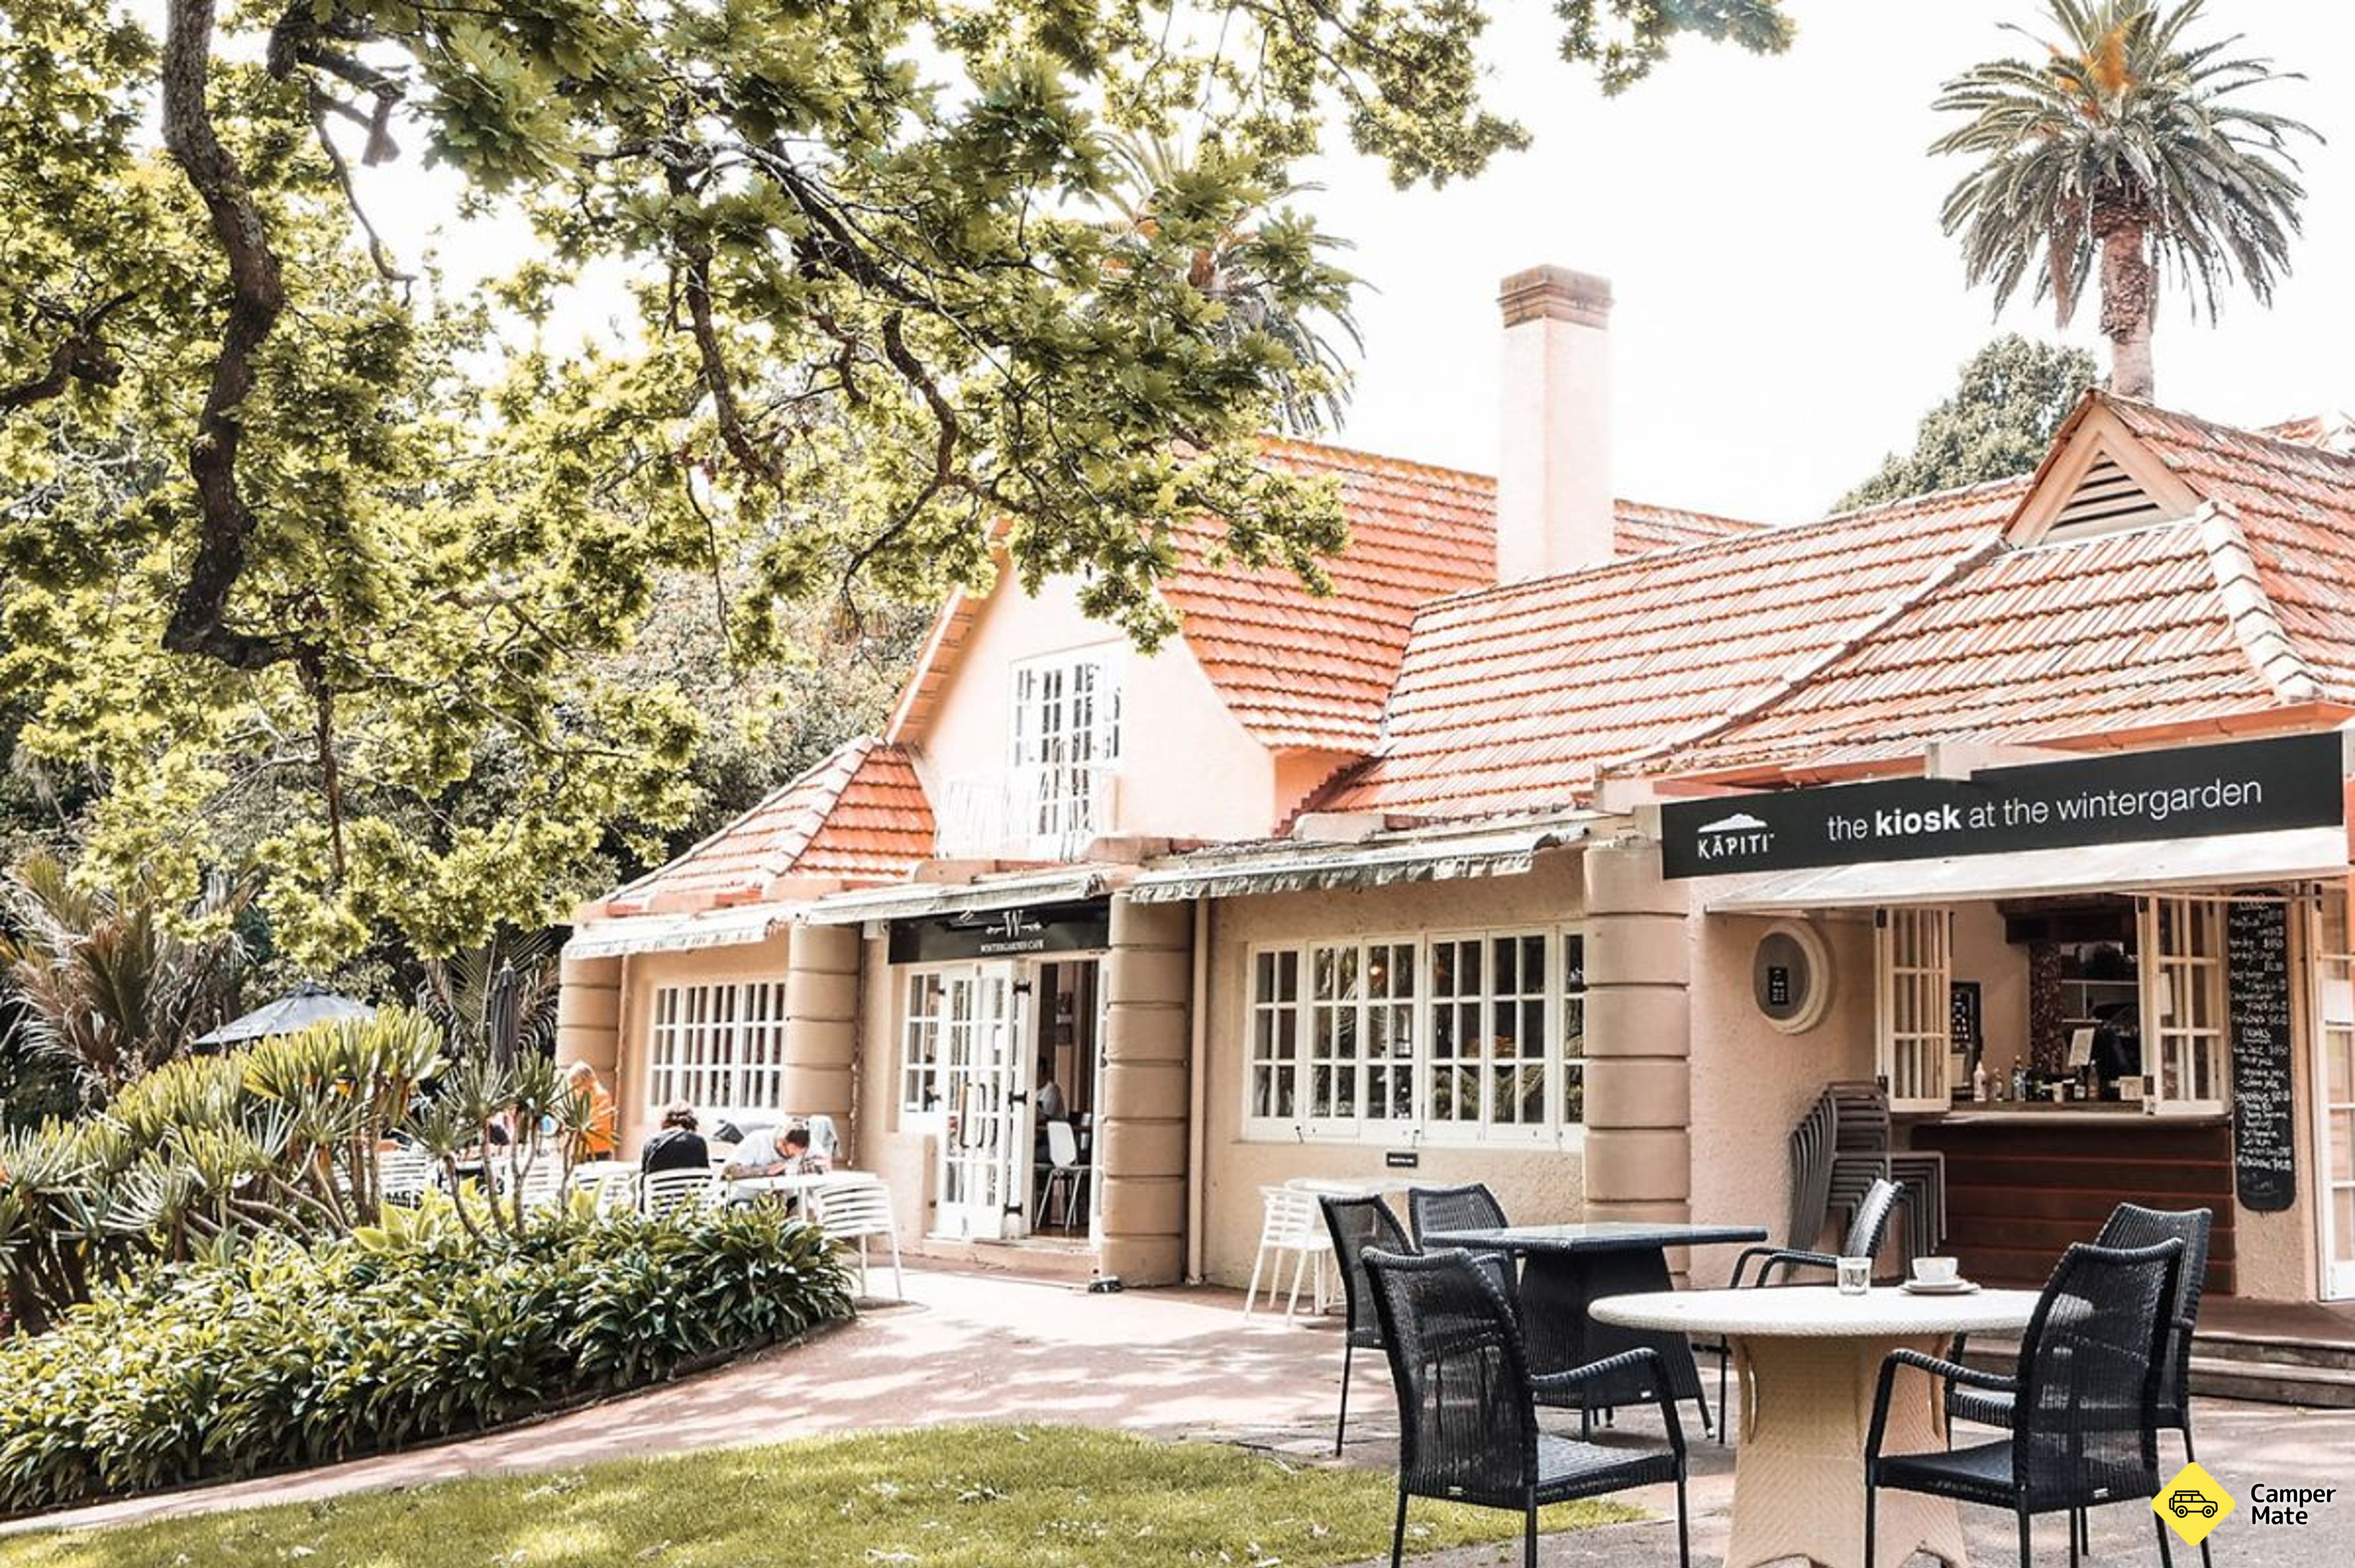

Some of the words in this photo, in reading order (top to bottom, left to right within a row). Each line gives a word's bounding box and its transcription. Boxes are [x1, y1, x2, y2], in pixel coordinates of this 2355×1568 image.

[1827, 815, 1868, 841] the
[1875, 803, 1962, 836] kiosk
[1969, 801, 1996, 829] at
[2004, 798, 2049, 825] the
[2057, 778, 2262, 821] wintergarden
